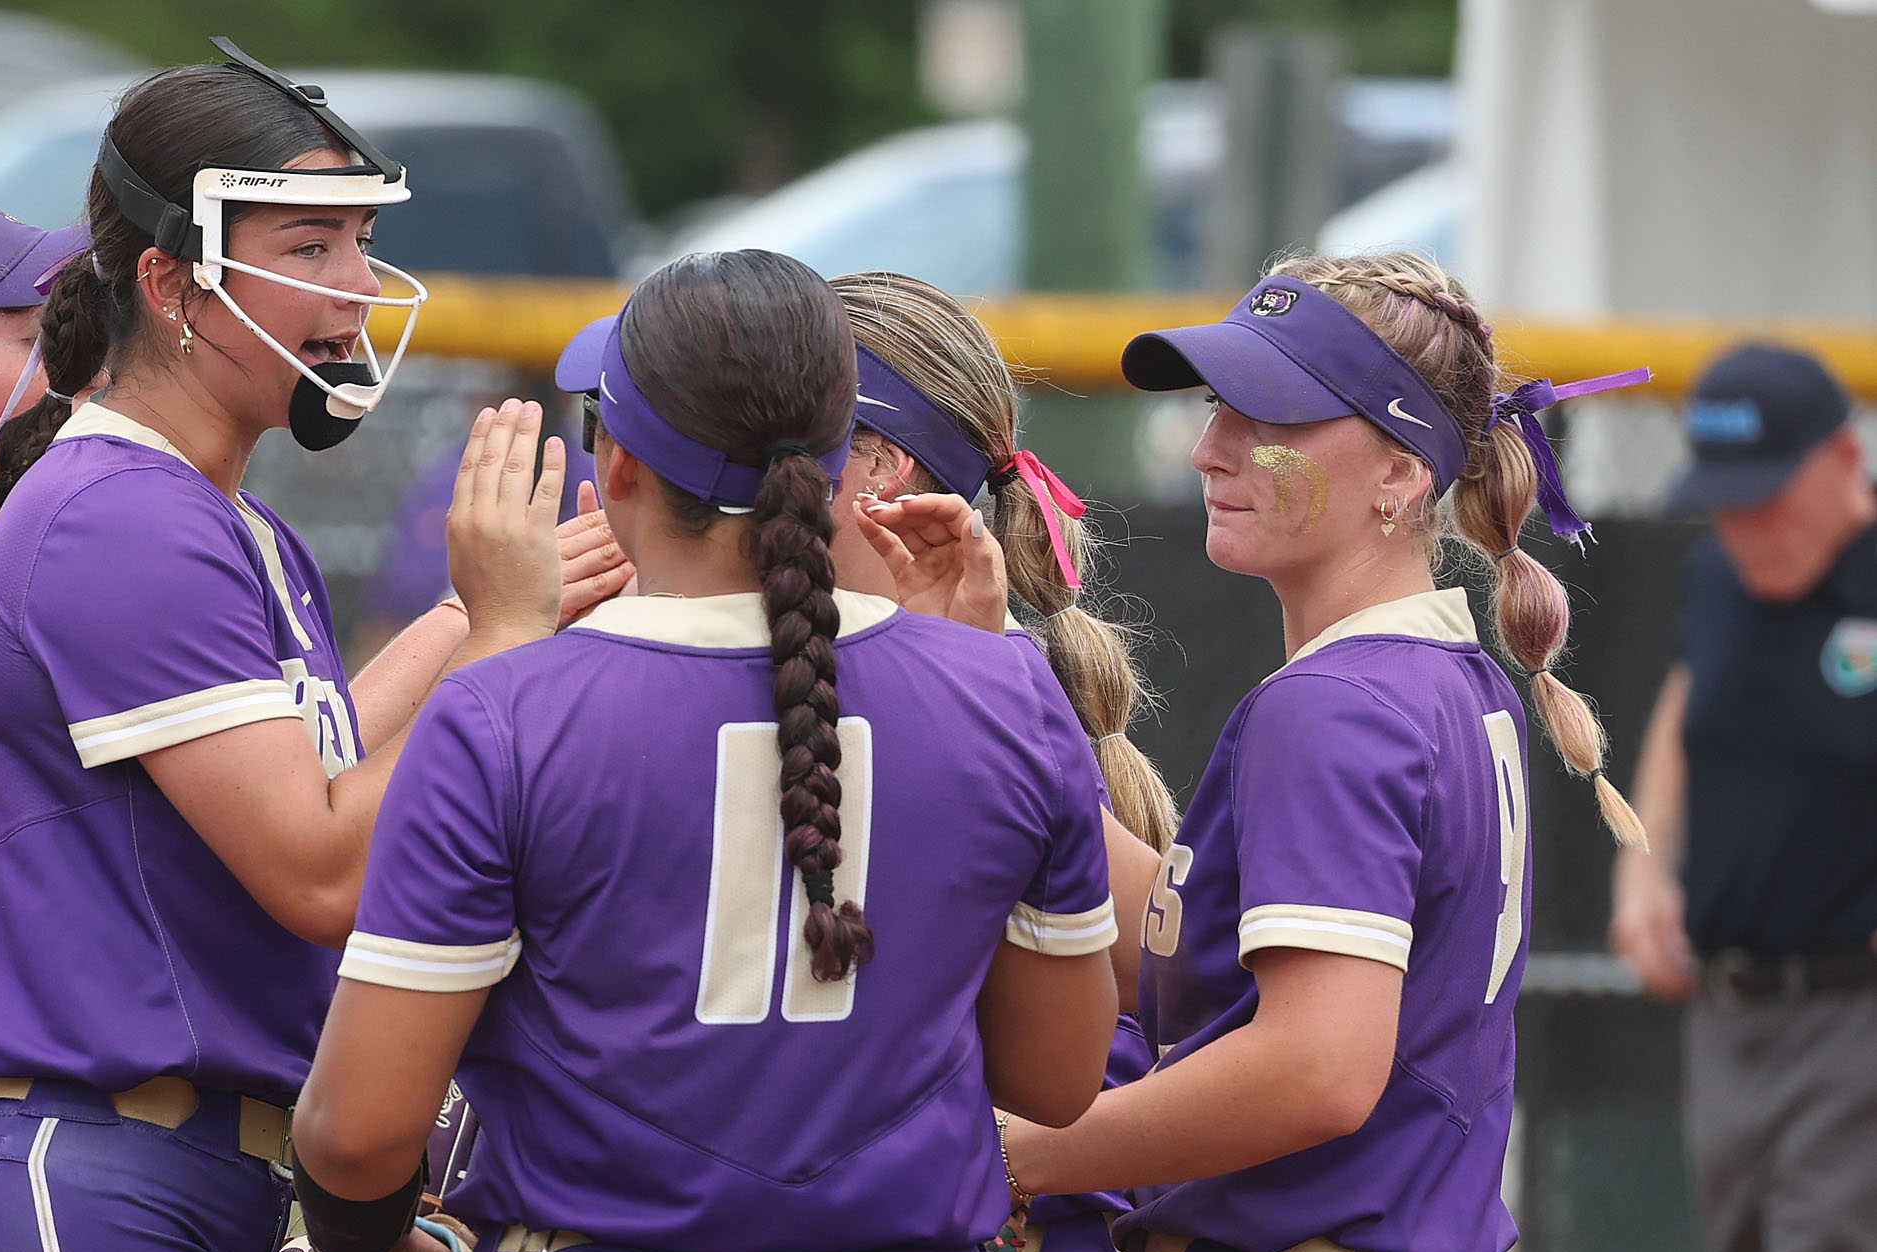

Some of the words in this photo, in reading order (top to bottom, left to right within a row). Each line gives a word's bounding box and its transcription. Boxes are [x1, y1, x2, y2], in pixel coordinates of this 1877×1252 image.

[238, 176, 288, 188] RIP-IT
[695, 715, 873, 1025] 11
[1482, 709, 1526, 1004] 9
